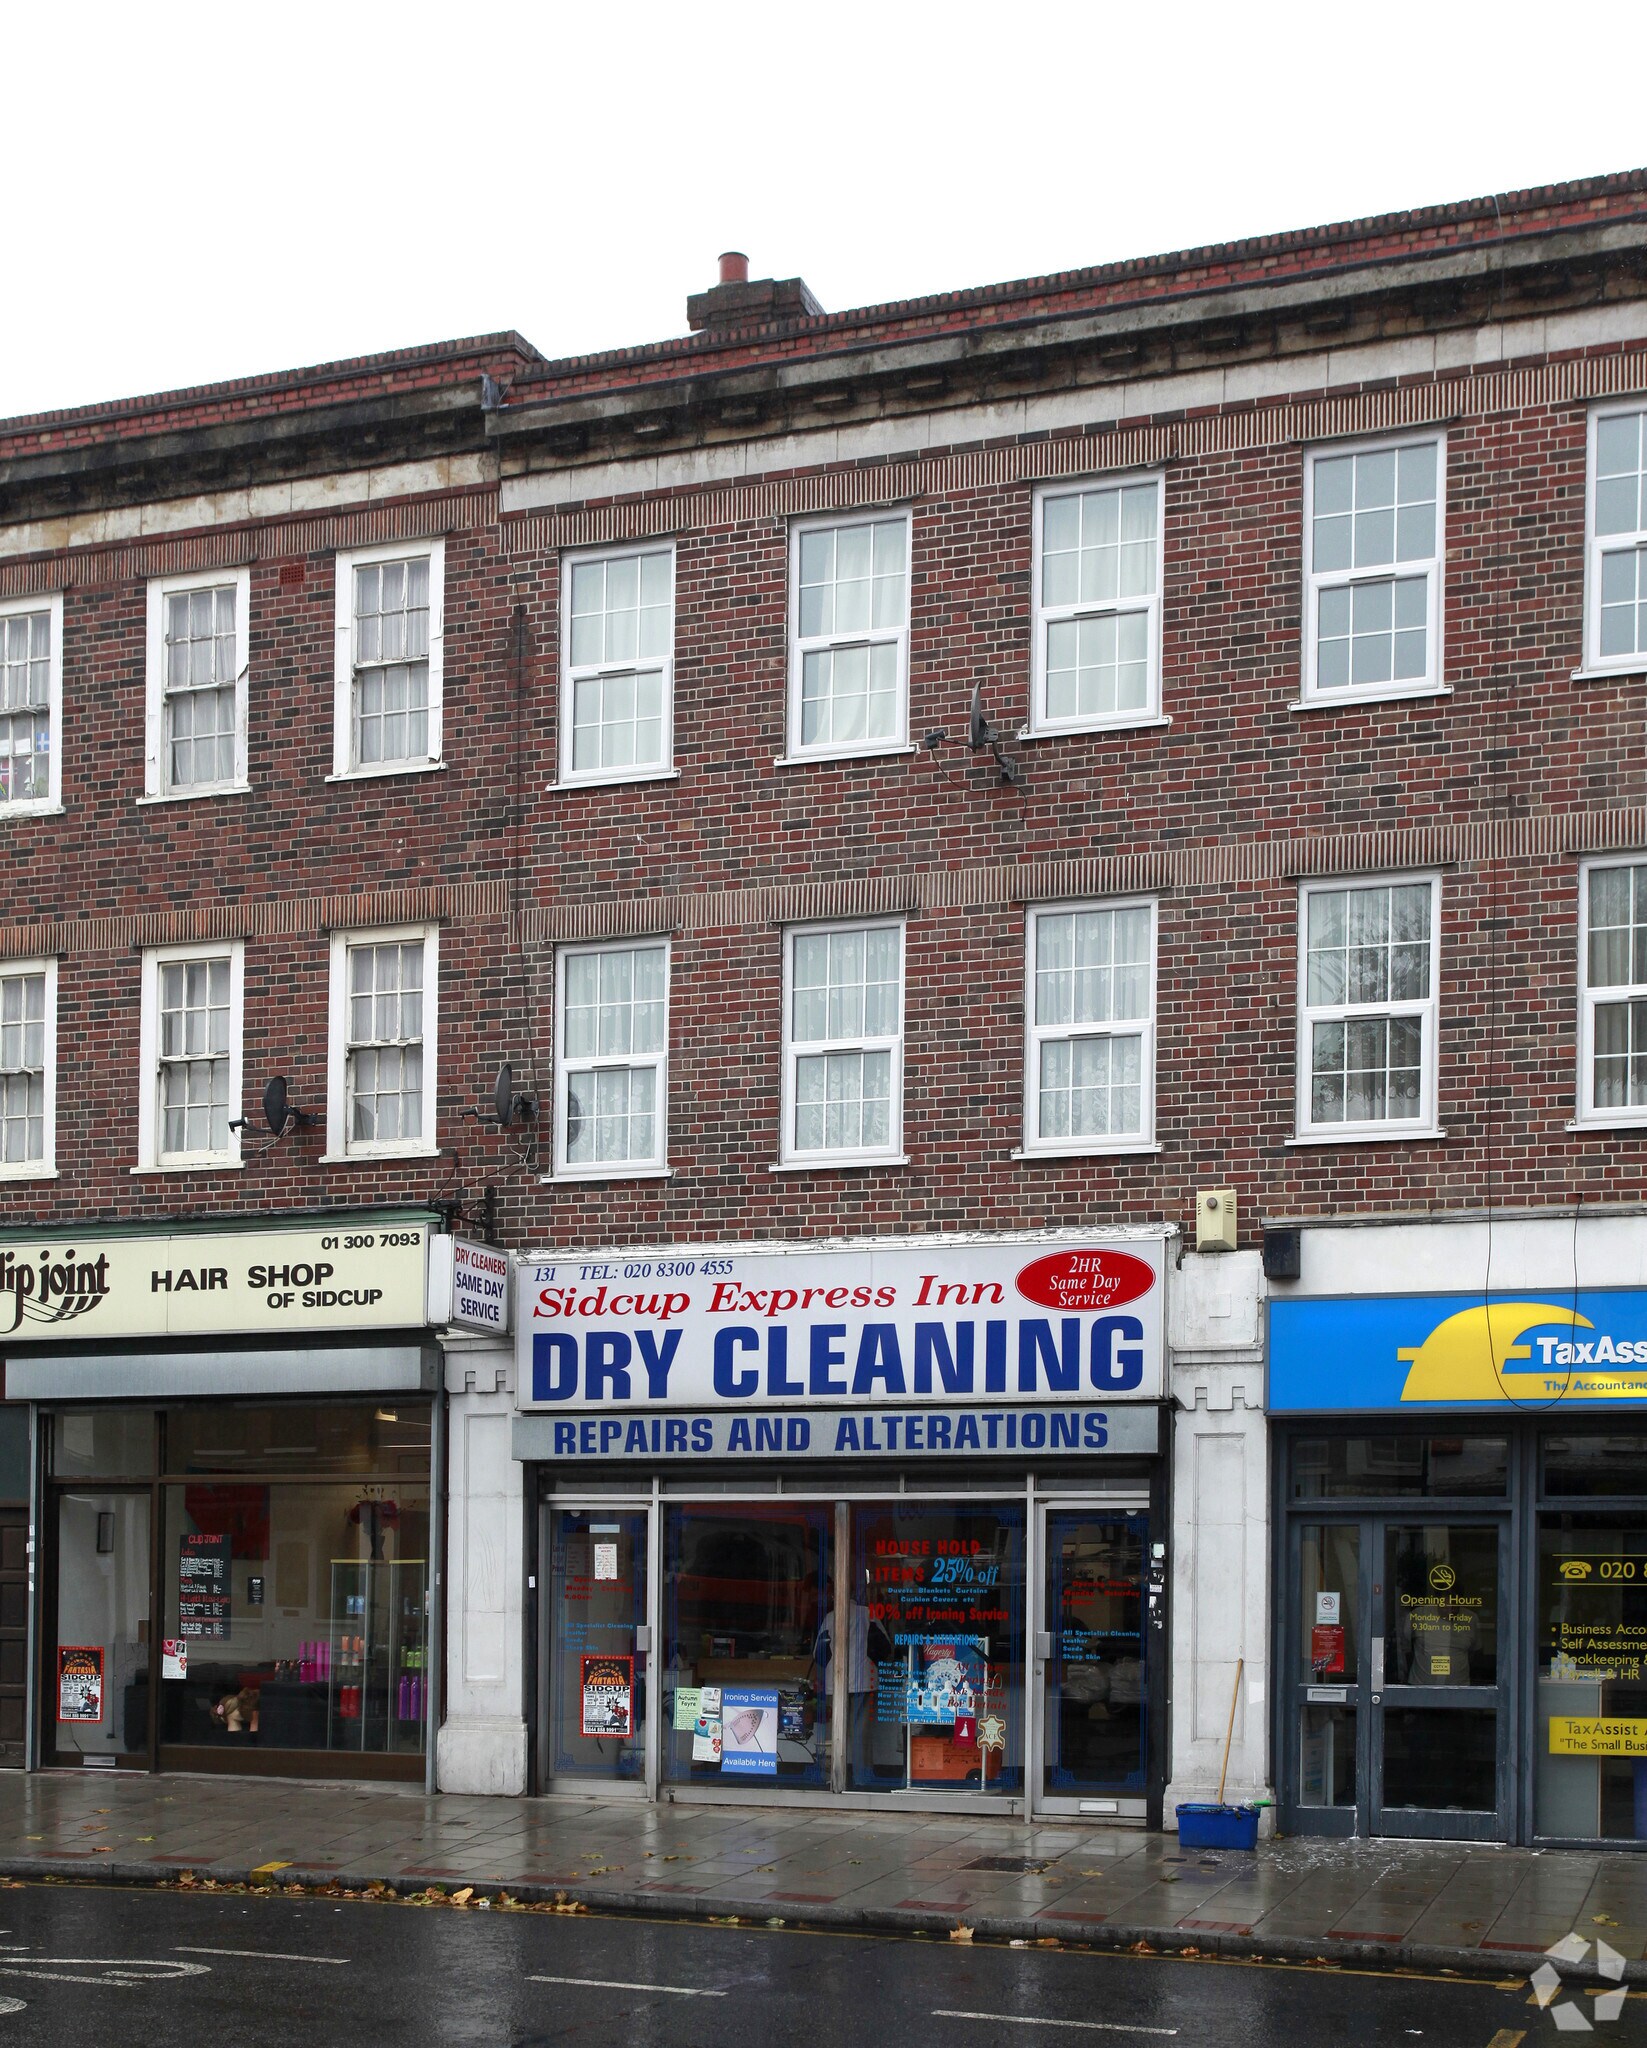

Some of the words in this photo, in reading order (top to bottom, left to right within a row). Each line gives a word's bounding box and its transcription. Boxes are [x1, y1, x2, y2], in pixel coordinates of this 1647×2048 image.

[321, 1236, 339, 1250] 01
[343, 1234, 375, 1249] 300
[380, 1232, 421, 1247] 7093
[455, 1246, 470, 1265] DRY
[471, 1252, 507, 1276] CLEANERS
[1068, 1255, 1102, 1273] 2HR
[38, 1249, 110, 1303] joint
[151, 1267, 228, 1293] HAIR
[247, 1263, 334, 1289] SHOP
[534, 1266, 556, 1282] 131
[579, 1264, 619, 1281] TEL:
[624, 1263, 652, 1279] 020
[655, 1261, 695, 1278] 8300
[699, 1260, 734, 1276] 4555
[456, 1271, 483, 1294] SAME
[484, 1279, 505, 1299] DAY
[1049, 1275, 1087, 1290] Same
[1092, 1273, 1121, 1292] Day
[267, 1291, 295, 1309] OF
[301, 1288, 383, 1308] SIDCUP
[532, 1286, 691, 1320] Sidcup
[706, 1282, 897, 1317] Express
[911, 1275, 1005, 1307] Inn
[1058, 1290, 1111, 1306] Service
[461, 1297, 500, 1322] SERVICE
[532, 1328, 684, 1401] DRY
[713, 1315, 1144, 1398] CLEANING
[1536, 1335, 1647, 1365] TaxAss
[1544, 1380, 1569, 1391] The
[554, 1418, 713, 1454] REPAIRS
[727, 1417, 811, 1452] AND
[834, 1412, 1109, 1451] ALTERATIONS
[875, 1538, 931, 1555] HOUSE
[937, 1538, 981, 1555] HOLD
[875, 1566, 925, 1582] ITEMS
[931, 1557, 975, 1583] 25%
[977, 1565, 1000, 1586] off
[1599, 1561, 1636, 1579] 020
[1400, 1594, 1446, 1608] Opening
[1449, 1594, 1483, 1606] Hours
[869, 1602, 901, 1621] 10%
[905, 1605, 923, 1620] off
[926, 1606, 965, 1624] Ironing
[969, 1607, 1009, 1621] Service
[1409, 1613, 1441, 1624] Monday
[1448, 1613, 1473, 1624] Friday
[1075, 1630, 1108, 1638] Specialist
[1110, 1630, 1141, 1639] Cleaning
[1412, 1622, 1440, 1632] 9.30am
[1442, 1623, 1451, 1632] to
[1453, 1623, 1471, 1634] 5pm
[1561, 1622, 1612, 1635] Business
[894, 1633, 924, 1646] REPAIRS
[933, 1633, 979, 1646] ALTERATIONS
[1561, 1637, 1584, 1650] Self
[1586, 1638, 1647, 1650] Assessme
[63, 1664, 97, 1674] FANTASIA
[1561, 1652, 1640, 1669] Bookkeeping
[587, 1675, 625, 1685] FANTASIA
[1605, 1668, 1615, 1680] &
[1620, 1668, 1640, 1680] HR
[724, 1693, 749, 1703] Ironing
[751, 1693, 777, 1702] Service
[1565, 1721, 1638, 1736] TaxAssist
[1591, 1738, 1621, 1750] Small
[723, 1757, 757, 1767] Available
[758, 1759, 776, 1768] Here
